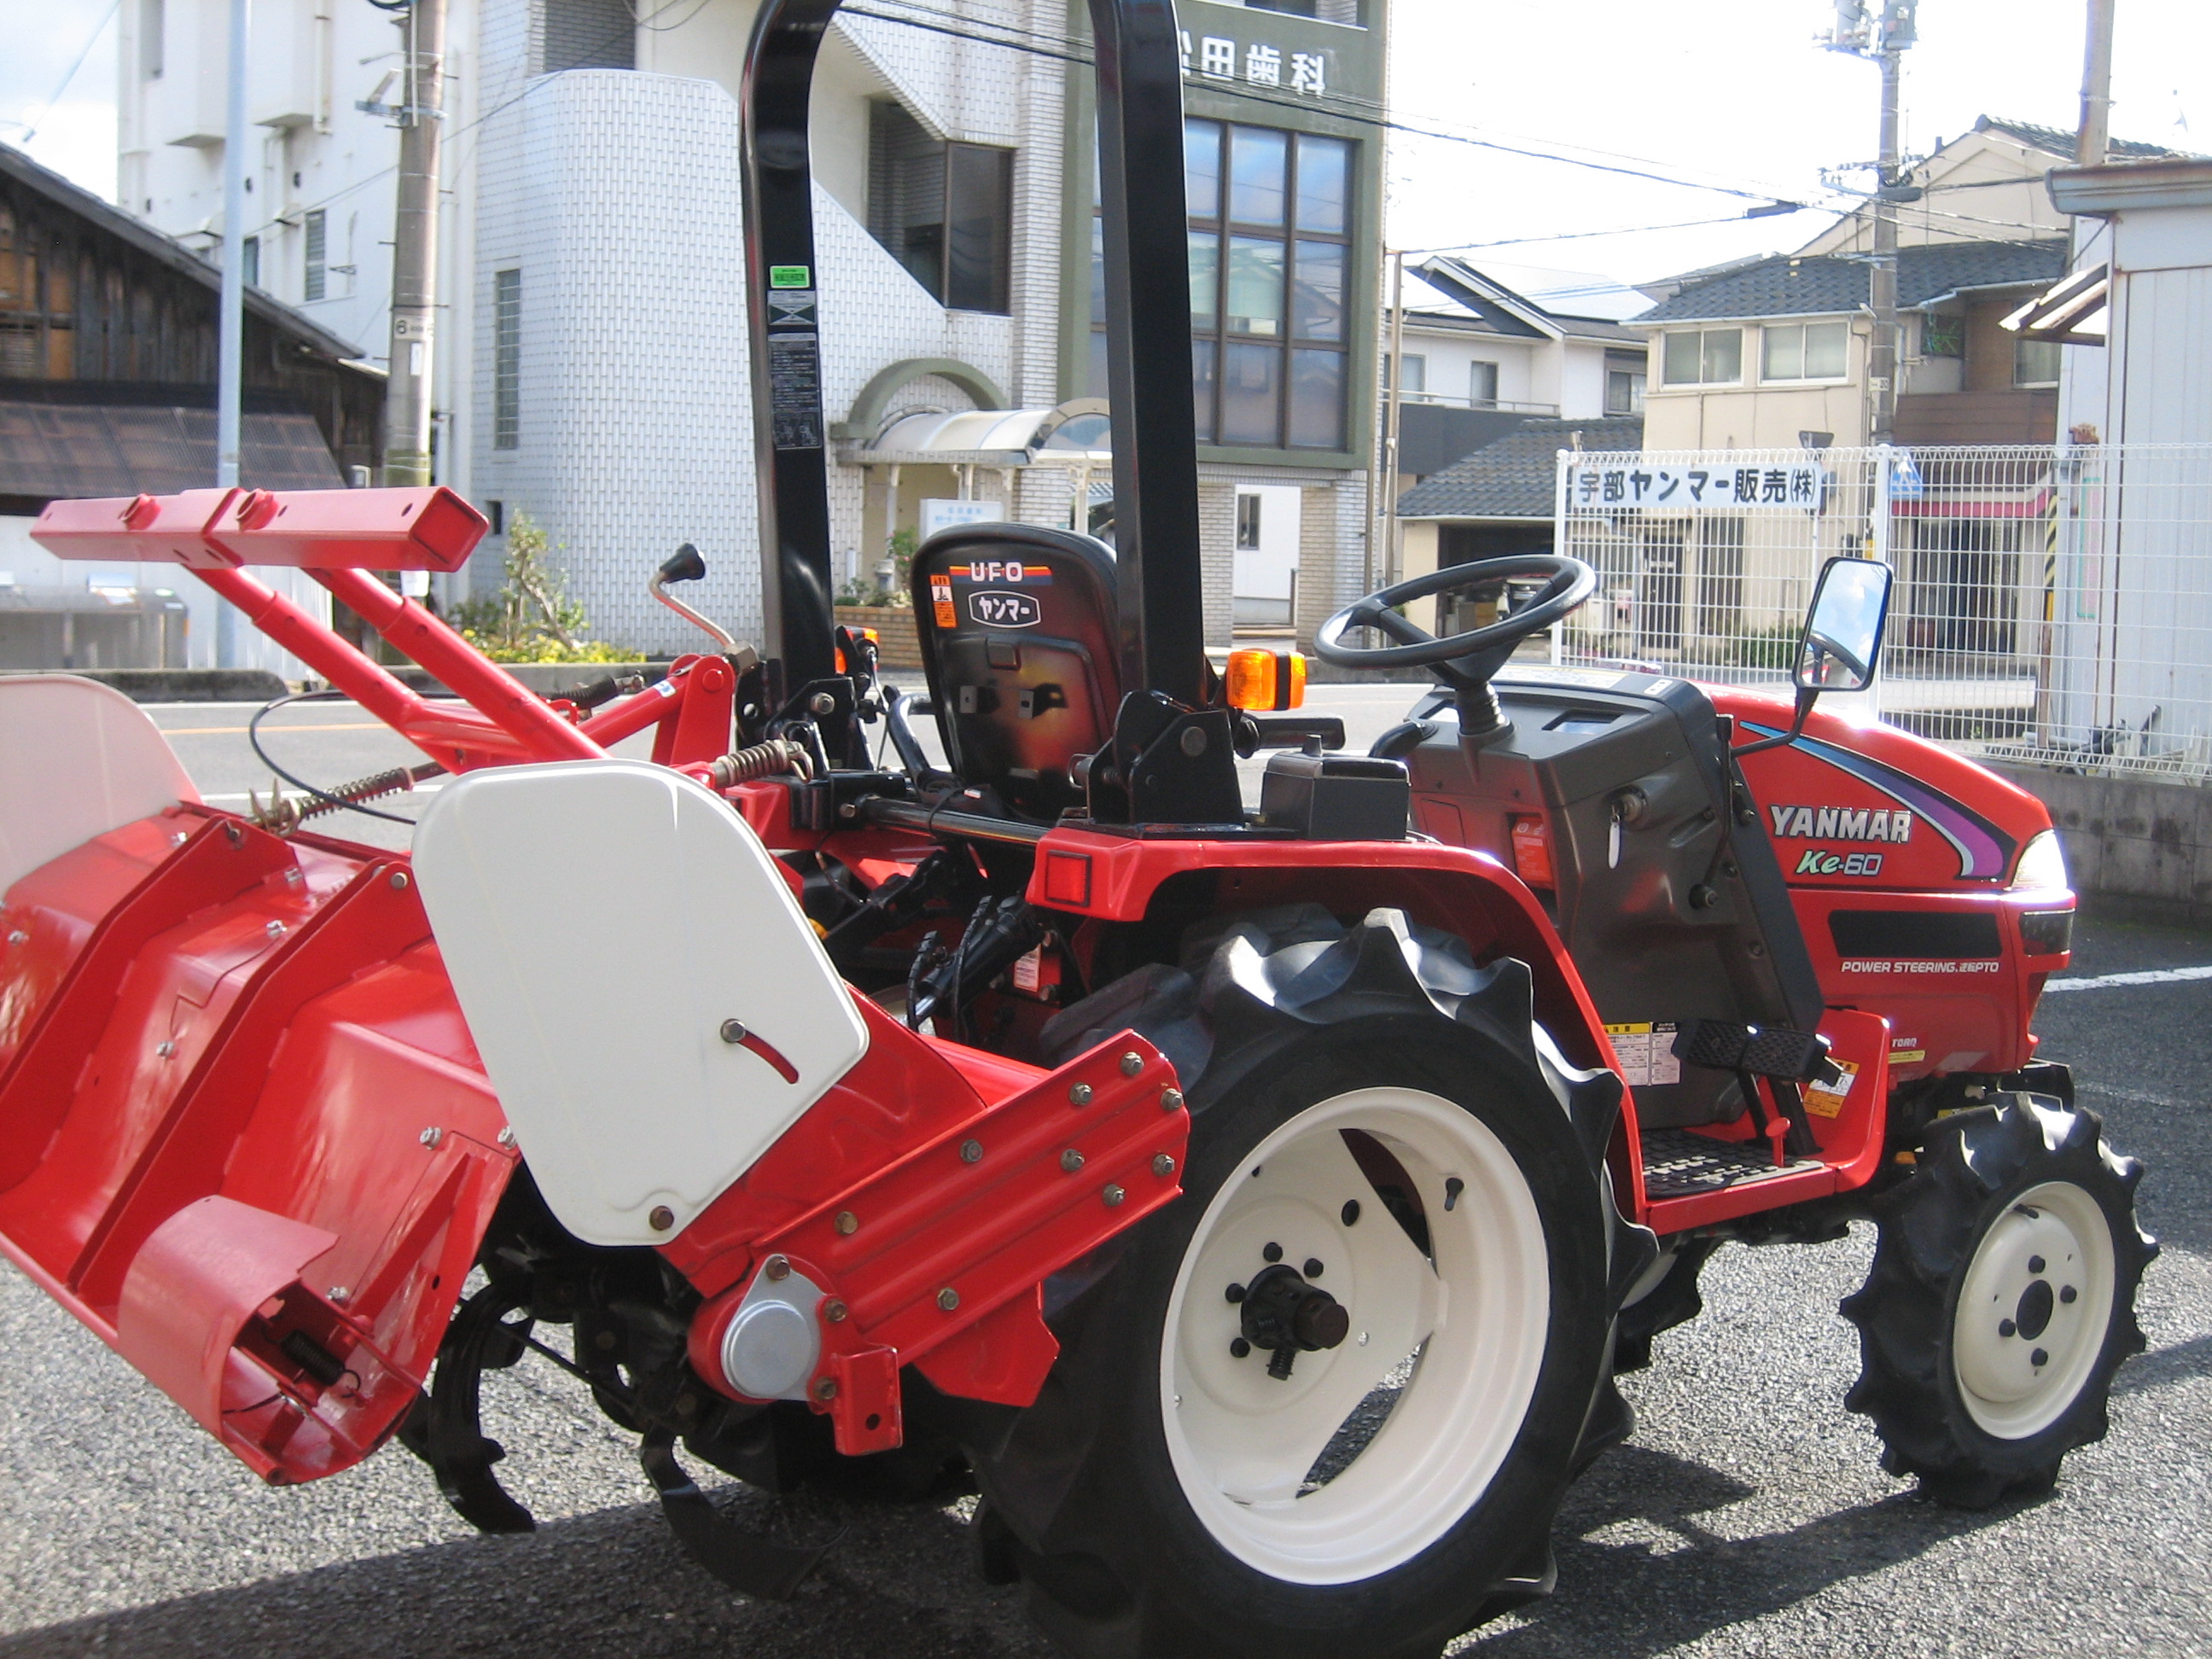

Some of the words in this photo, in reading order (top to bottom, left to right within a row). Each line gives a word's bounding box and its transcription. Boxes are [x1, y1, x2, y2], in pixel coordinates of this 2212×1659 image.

[970, 562, 1023, 582] UFO
[979, 596, 1030, 621] ヤンマー
[1769, 805, 1912, 843] YANMAR
[1796, 850, 1883, 876] Ke-60
[1841, 961, 1890, 973] POWER
